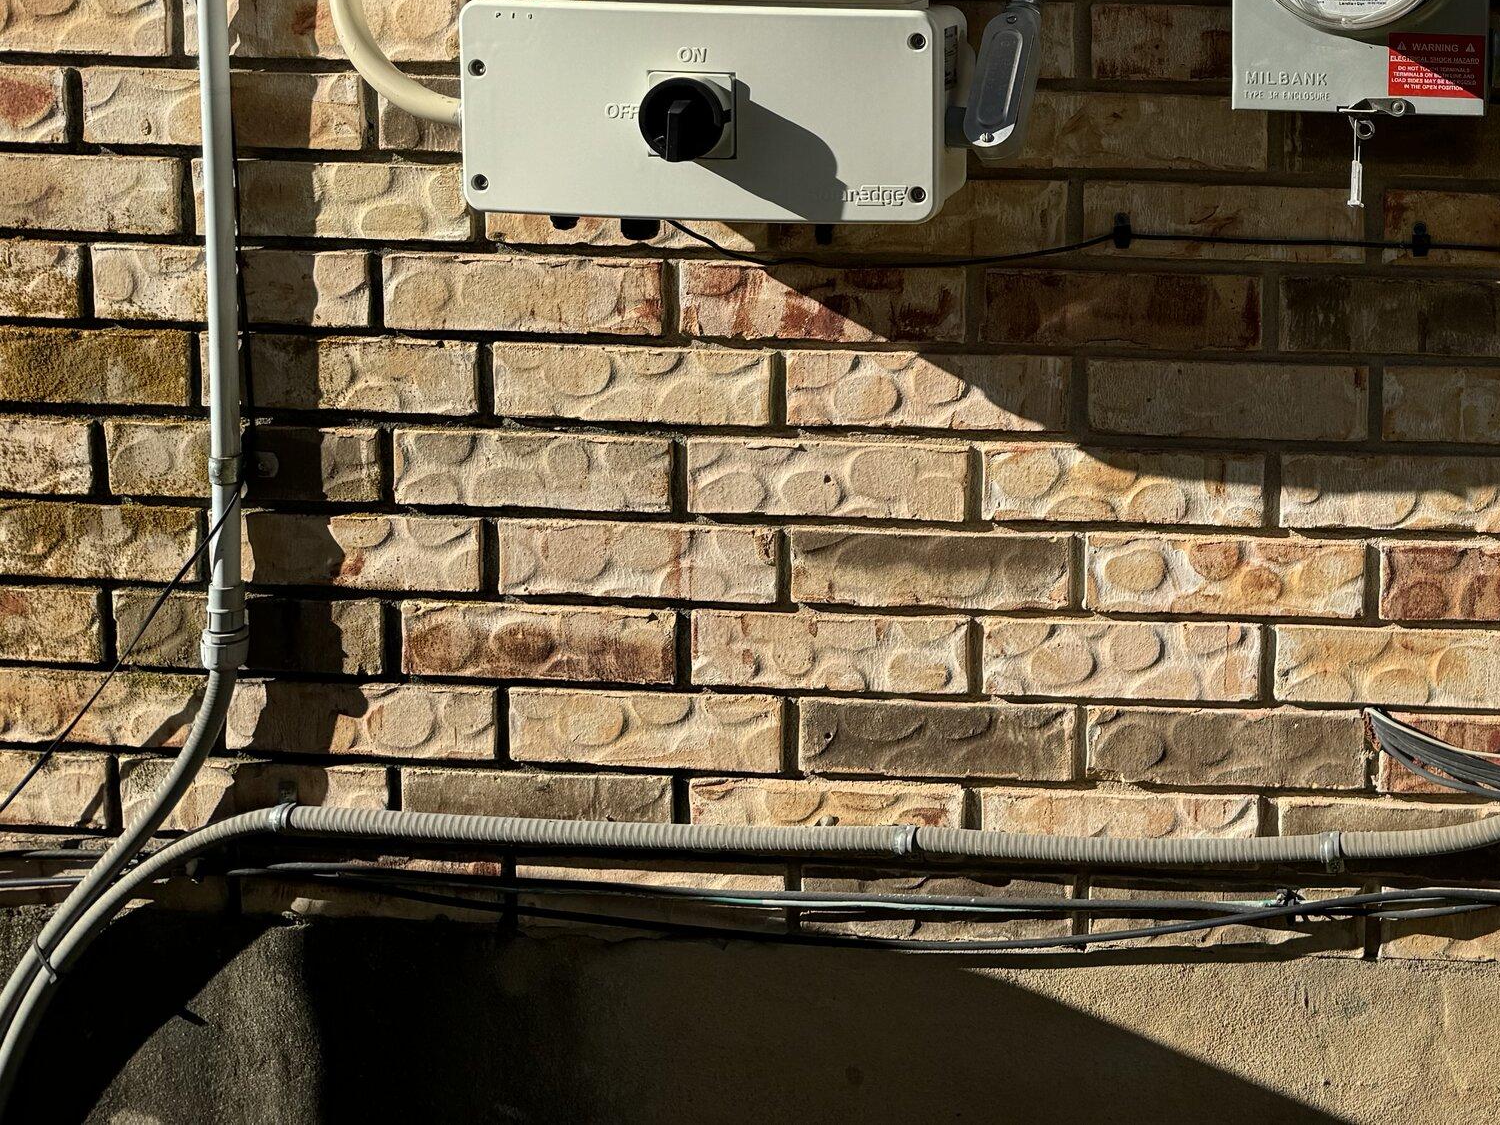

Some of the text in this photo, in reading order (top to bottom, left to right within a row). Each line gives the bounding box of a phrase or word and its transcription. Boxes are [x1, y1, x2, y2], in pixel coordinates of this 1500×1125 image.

[1411, 42, 1459, 53] WARNING
[676, 46, 709, 64] ON
[1245, 70, 1328, 86] MILBANK
[1244, 90, 1264, 100] TYPE
[1282, 91, 1331, 101] ENCLOSURE
